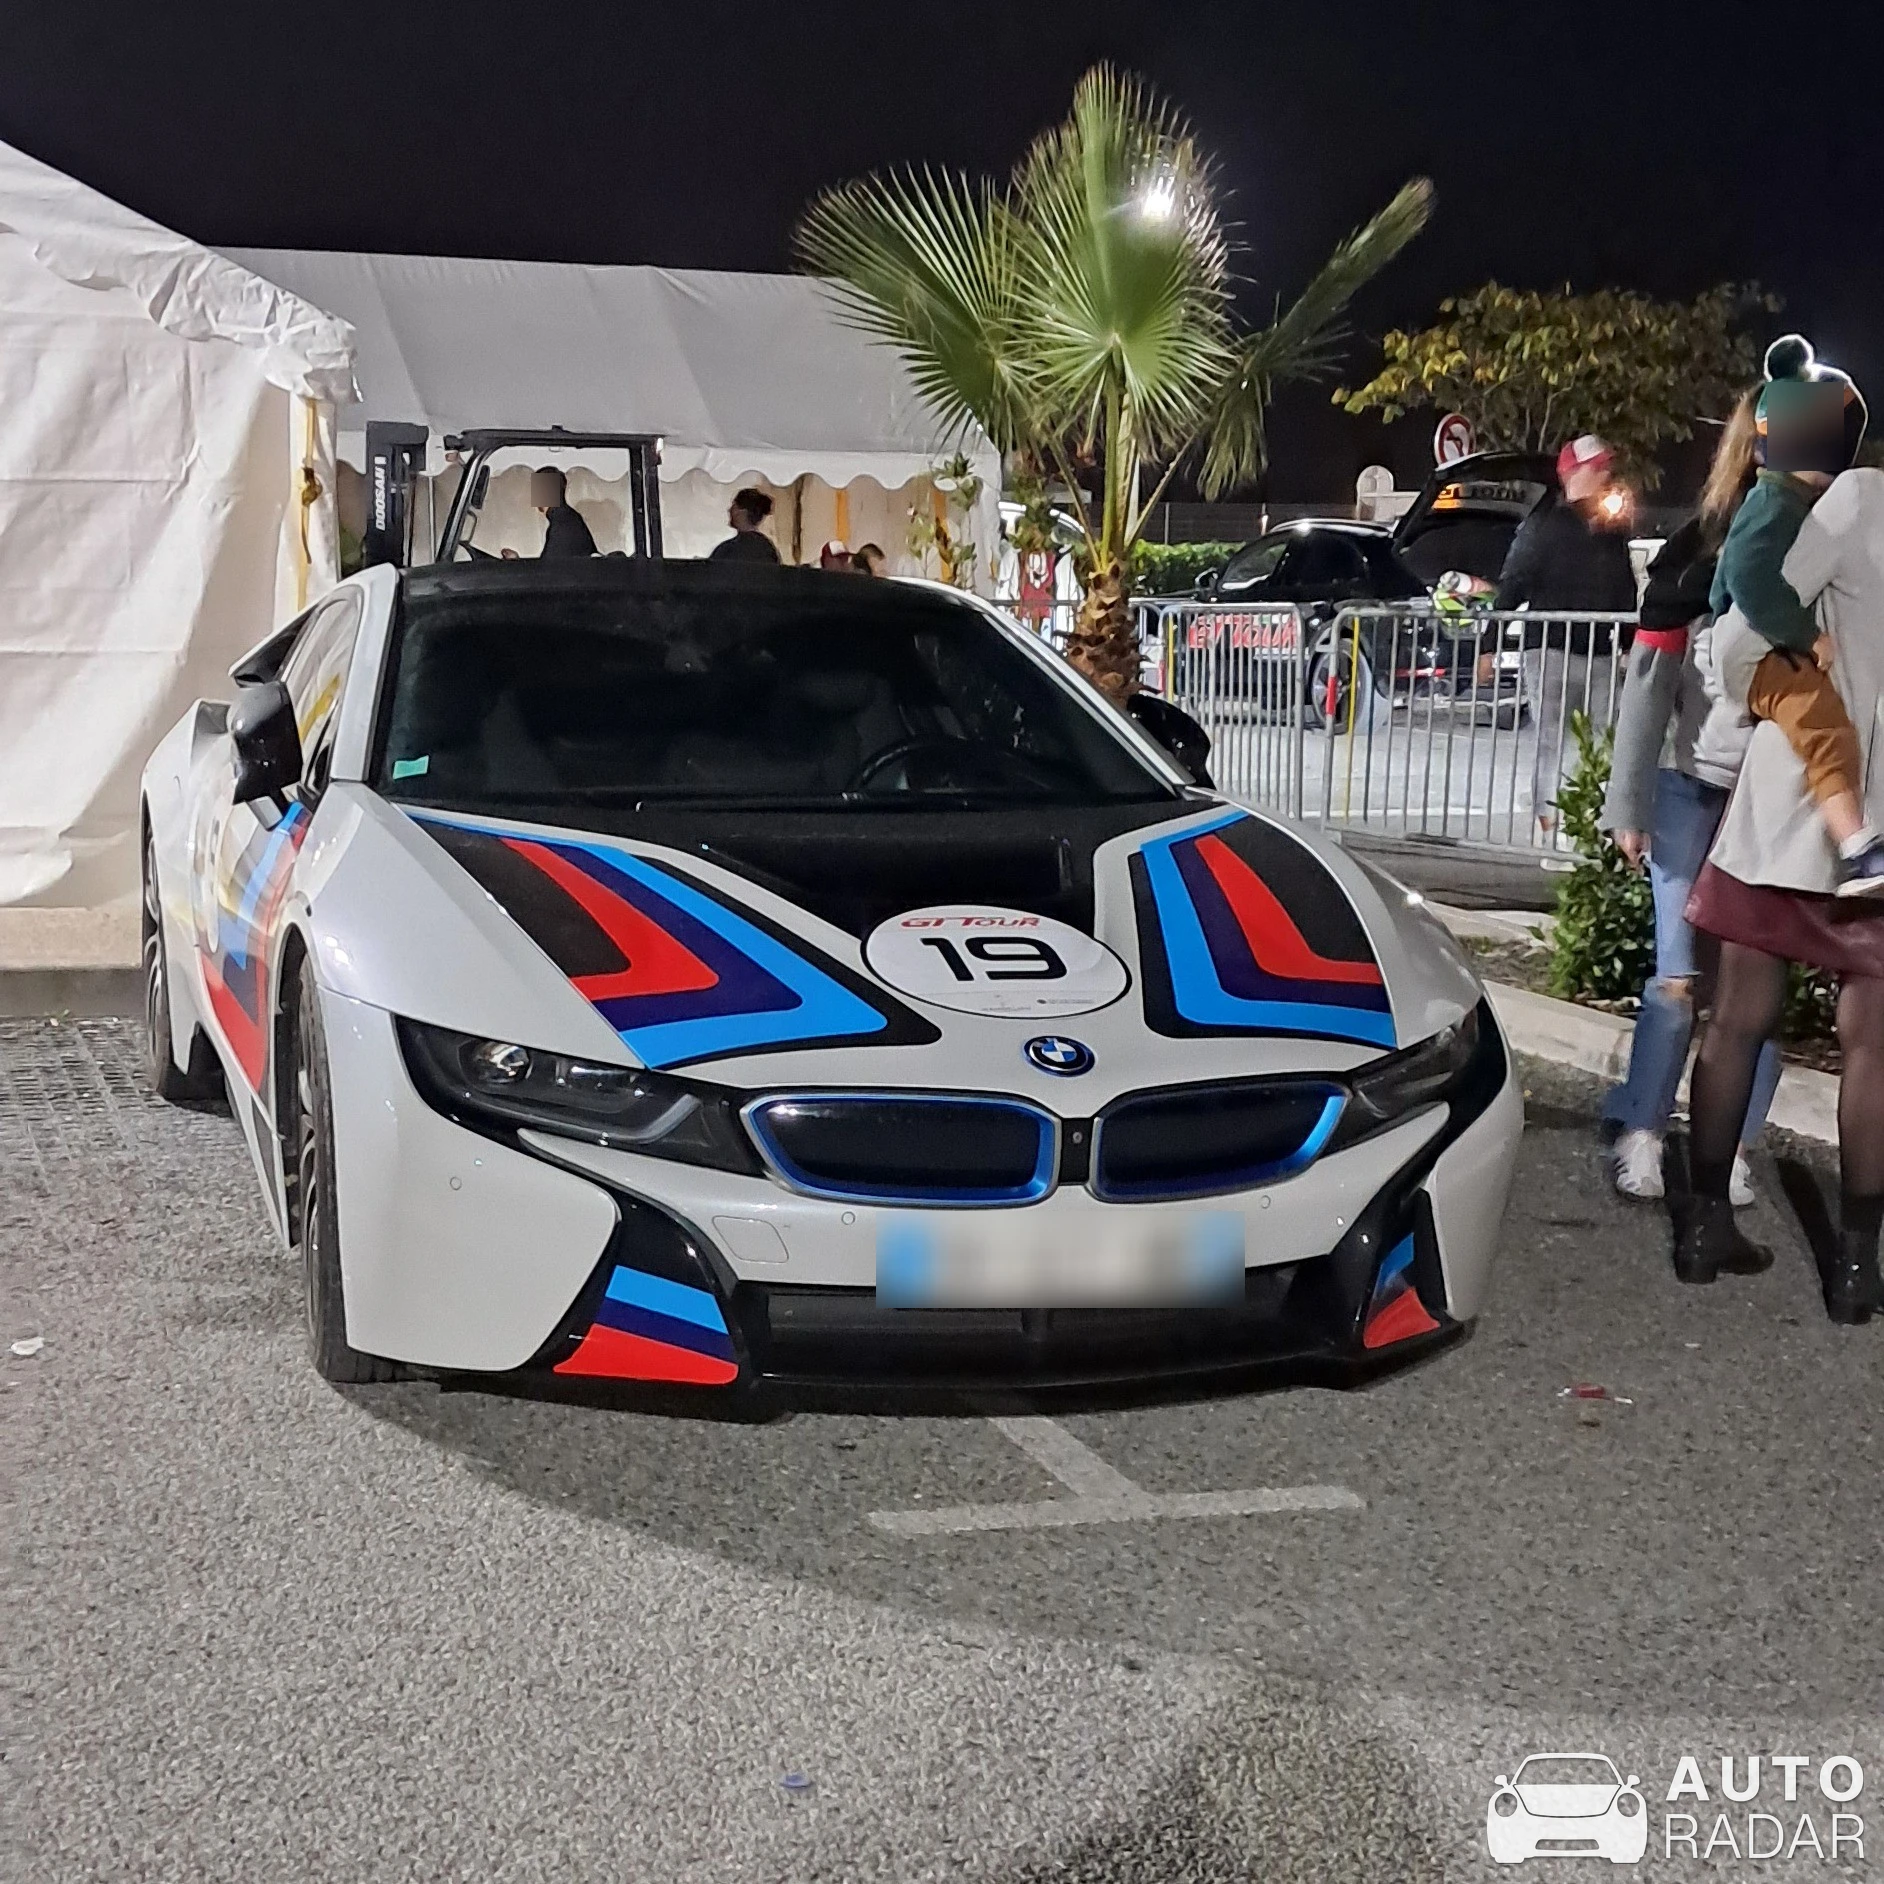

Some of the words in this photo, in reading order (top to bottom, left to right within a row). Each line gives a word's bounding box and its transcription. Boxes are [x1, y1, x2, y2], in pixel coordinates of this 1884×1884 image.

[375, 466, 386, 531] DOOSAN
[901, 917, 945, 928] GT
[920, 936, 1068, 982] 19
